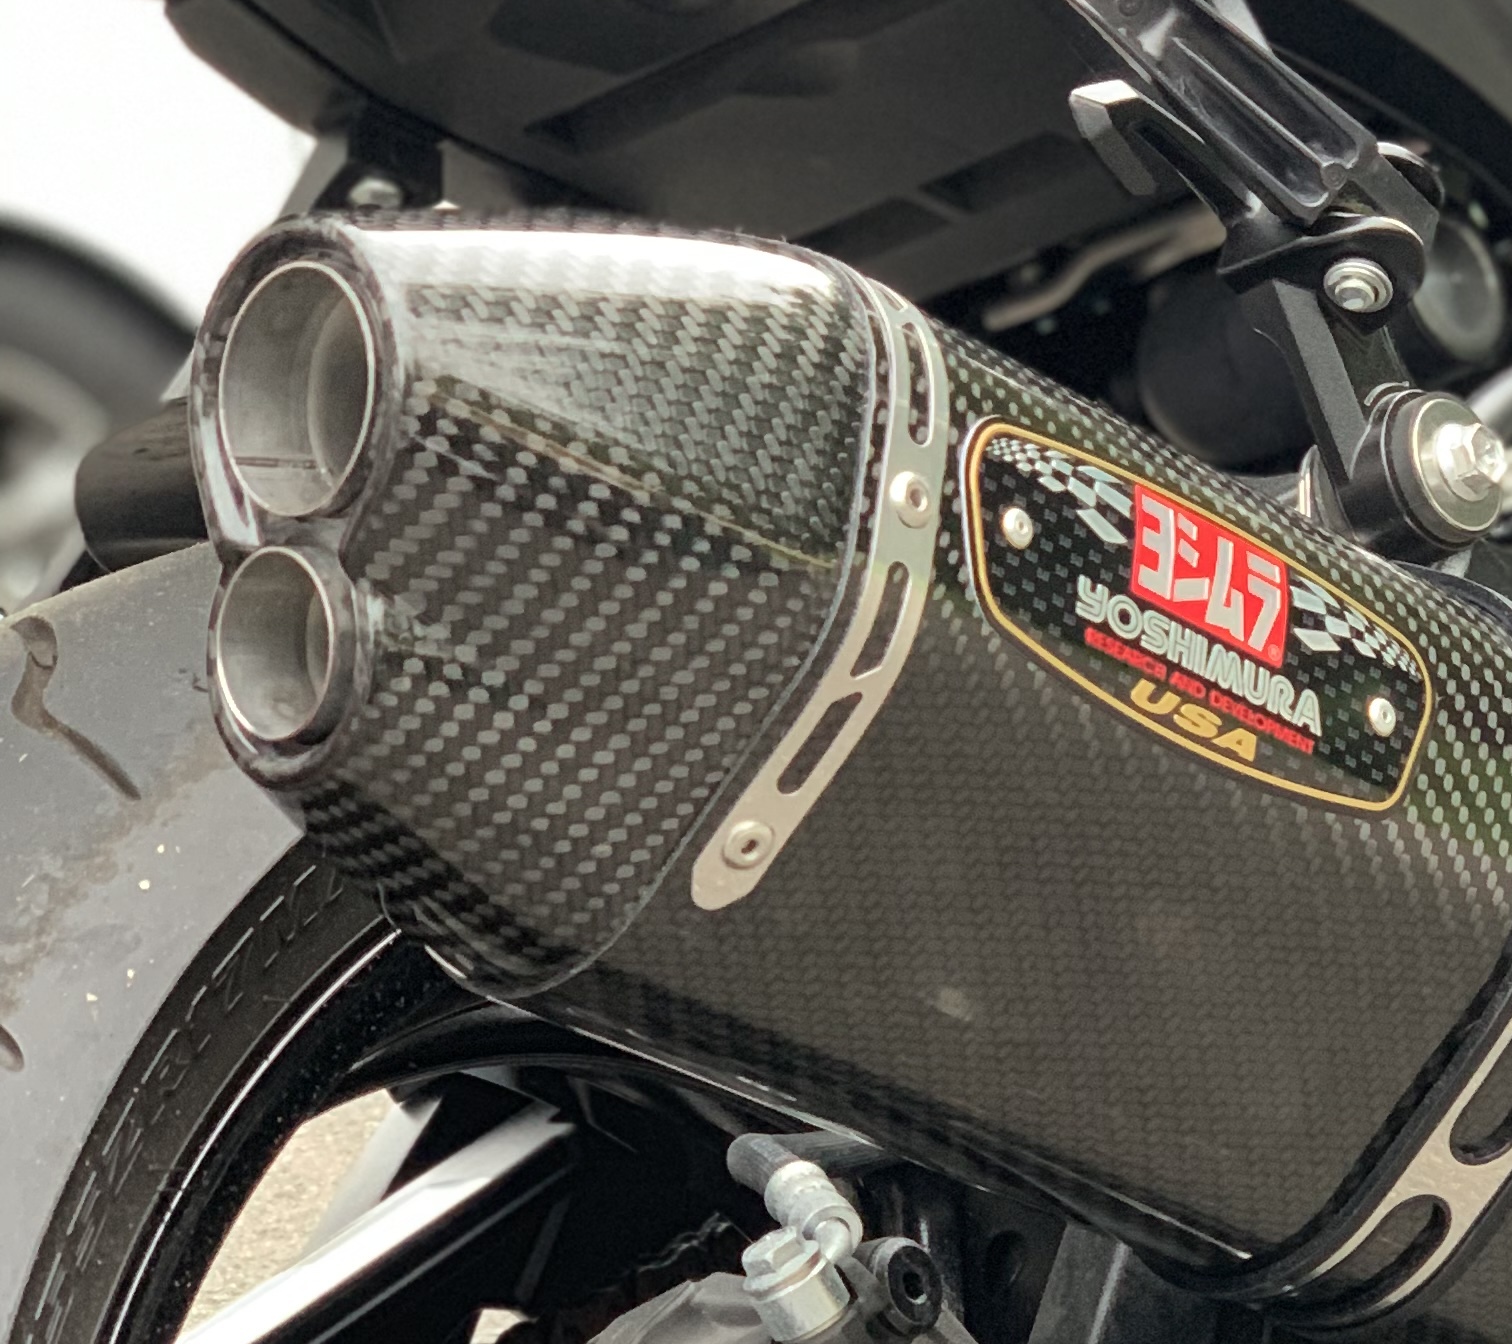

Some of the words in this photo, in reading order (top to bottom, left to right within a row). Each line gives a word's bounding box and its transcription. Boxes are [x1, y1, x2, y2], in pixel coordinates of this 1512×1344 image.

[1074, 573, 1323, 737] YOSHIMURA
[1083, 626, 1168, 681] RESEARCH
[1168, 670, 1207, 700] AND
[1208, 688, 1316, 756] DEVELOPMENT
[1129, 677, 1258, 763] USA
